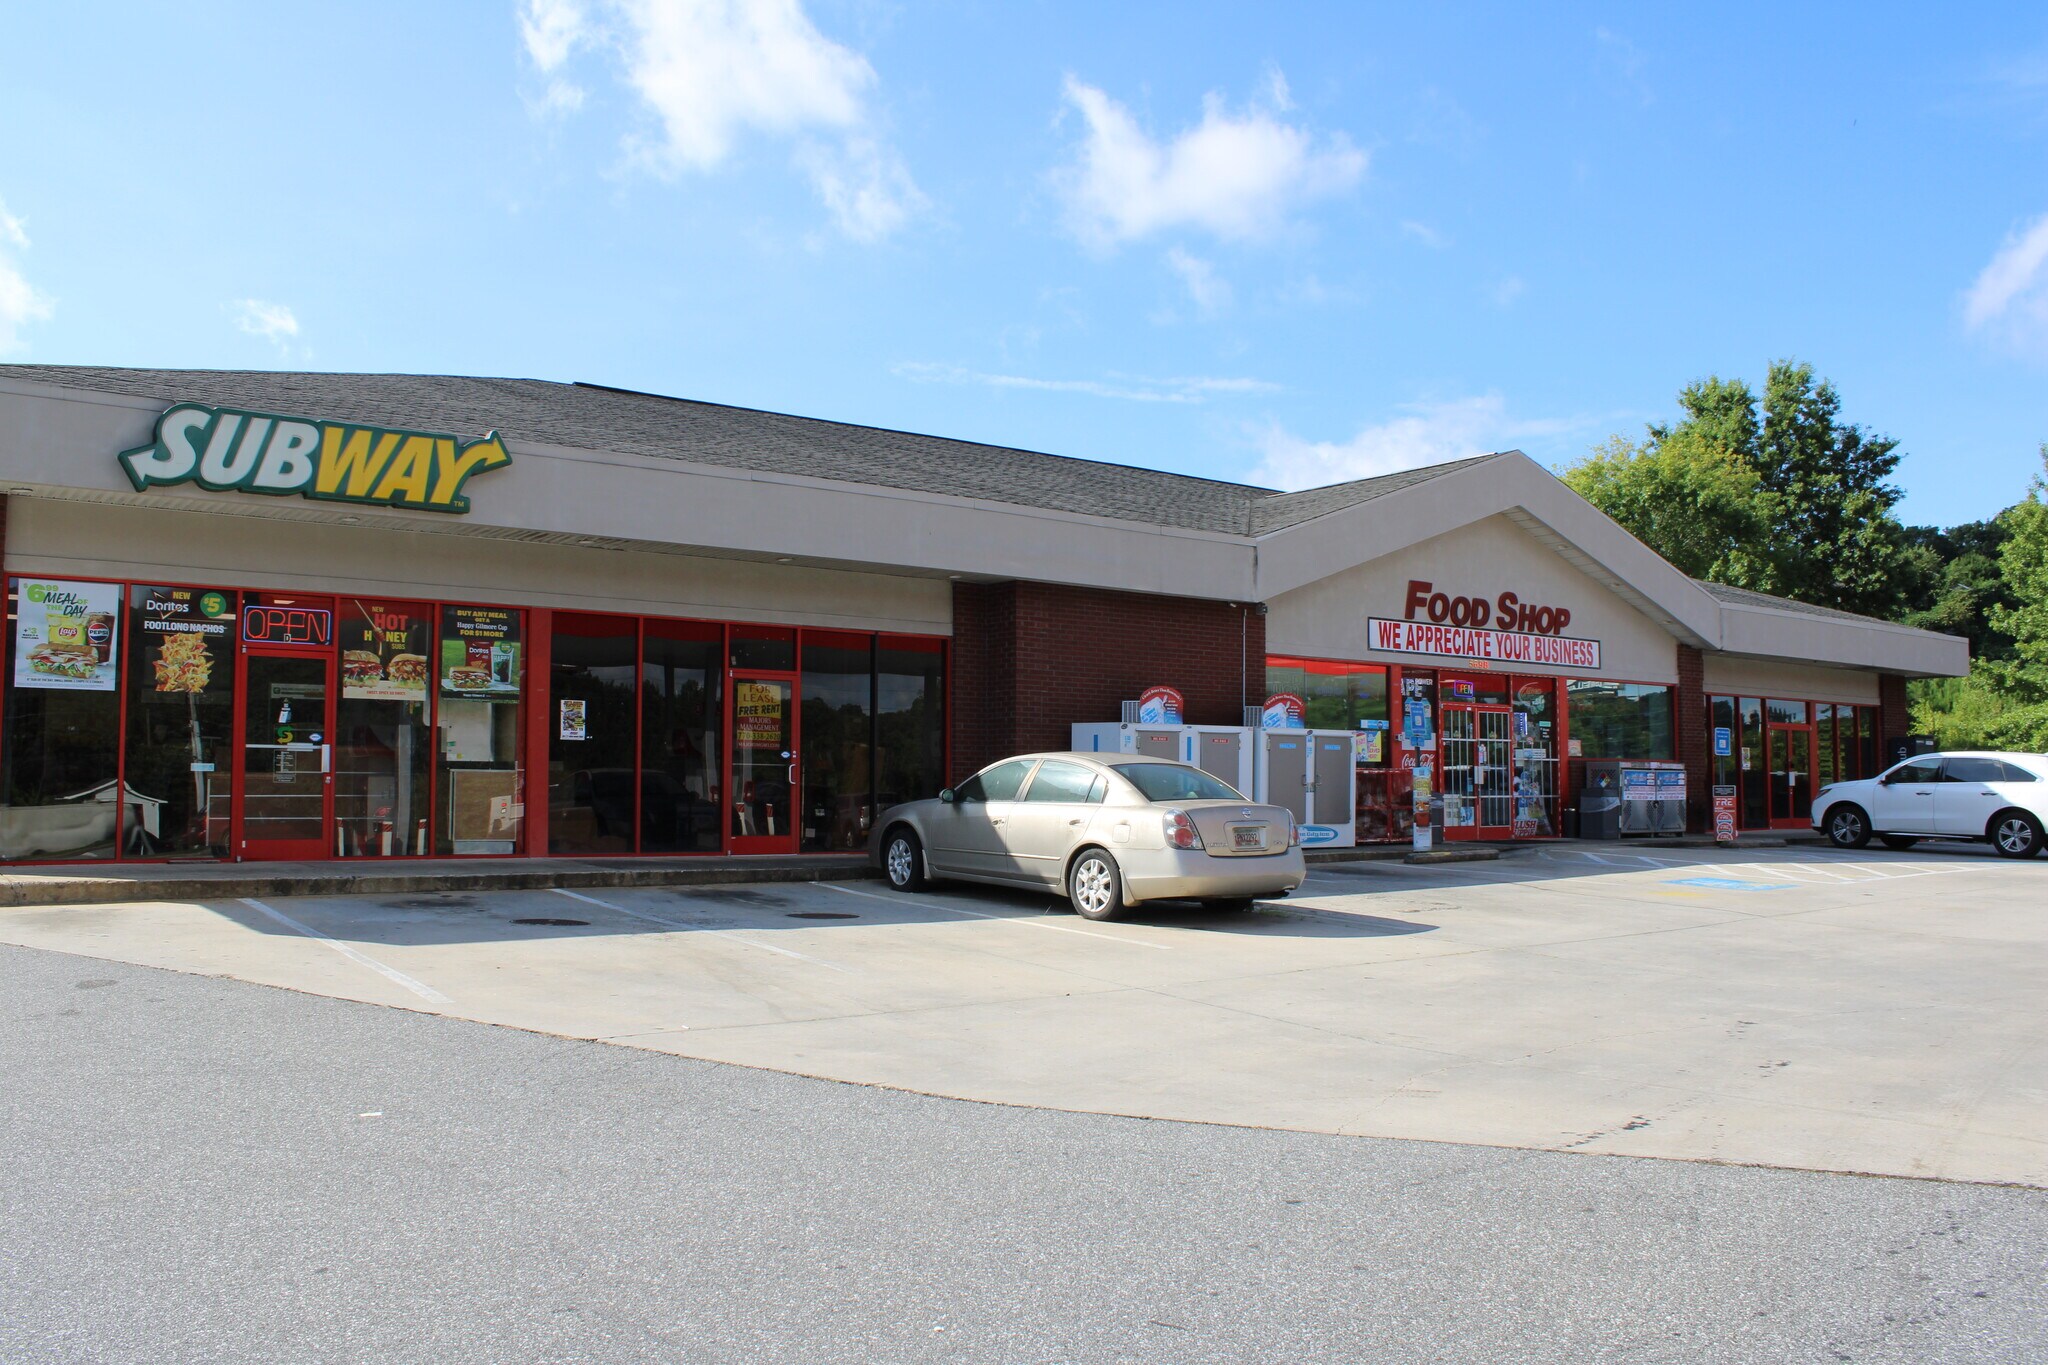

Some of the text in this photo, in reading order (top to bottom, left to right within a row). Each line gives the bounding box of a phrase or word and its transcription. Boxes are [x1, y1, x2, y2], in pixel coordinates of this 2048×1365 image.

[128, 407, 507, 505] SUBWAY
[43, 592, 78, 604] MEAL
[173, 591, 191, 599] NEW
[63, 605, 88, 618] DAY
[146, 600, 189, 612] Doritos
[1405, 580, 1571, 635] FOOD SHOP
[144, 621, 225, 633] FOOTLONG NACHOS
[246, 609, 327, 642] OPEN
[374, 614, 408, 630] HOT
[457, 622, 474, 630] Happy
[364, 630, 407, 642] HNEY
[1379, 621, 1594, 666] WE APPRECIATE YOUR BUSINESS
[750, 685, 771, 693] FOR
[743, 694, 777, 703] LEASE
[738, 704, 780, 715] FREE RENT
